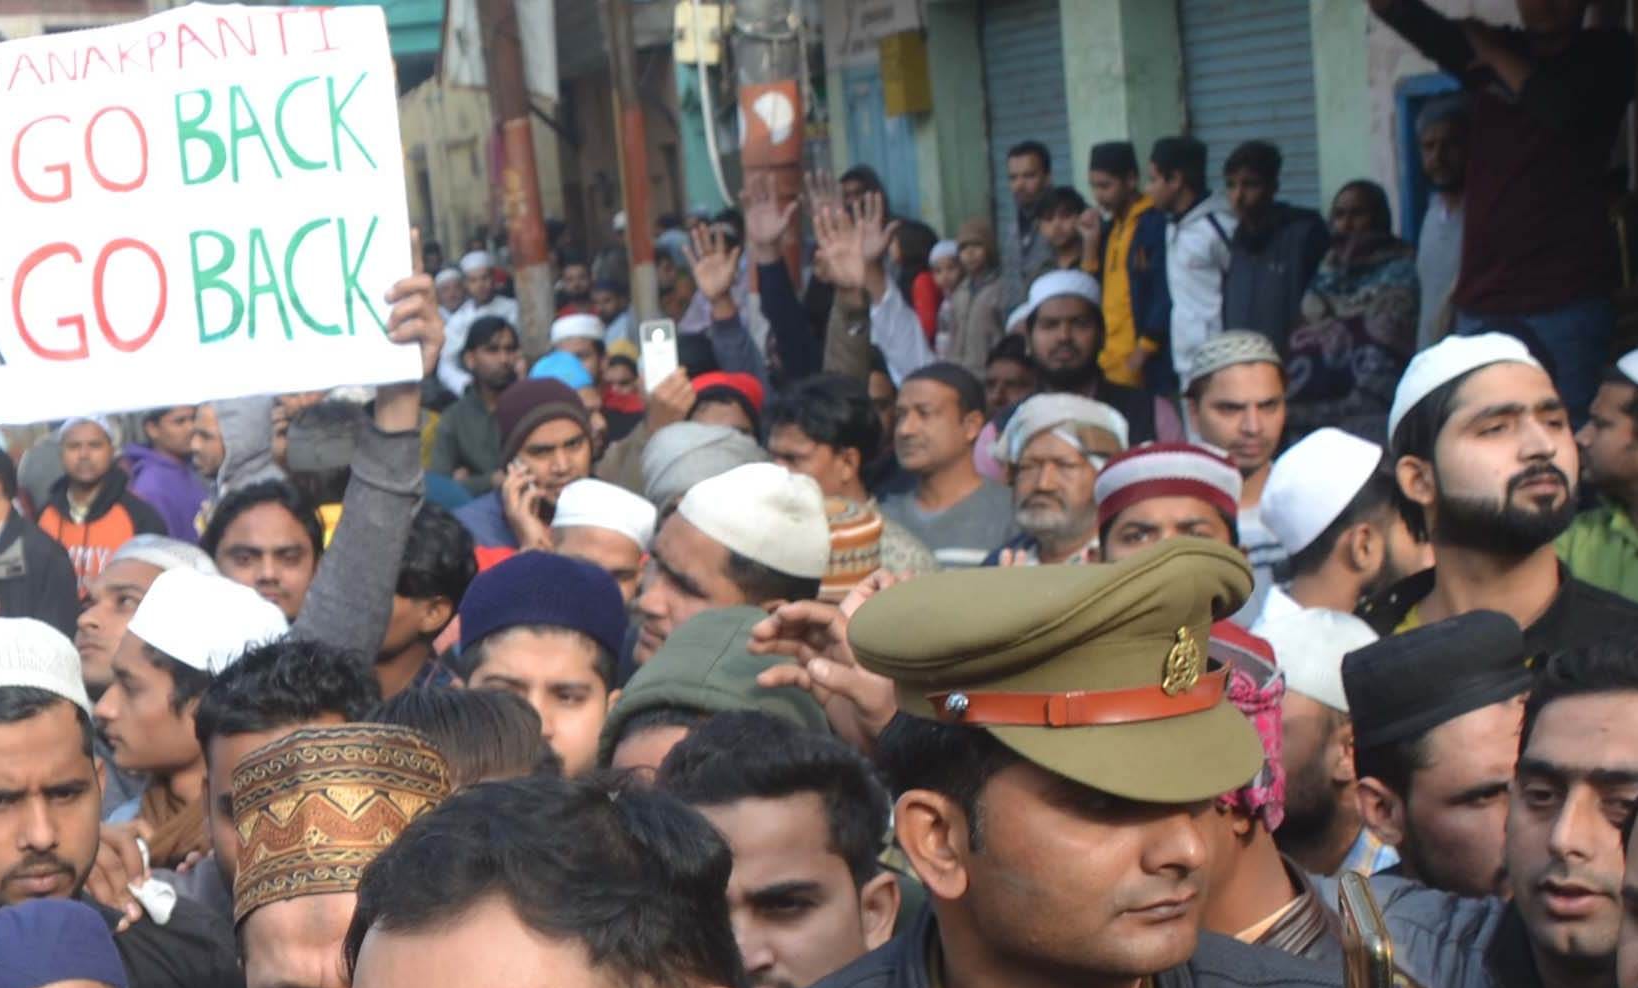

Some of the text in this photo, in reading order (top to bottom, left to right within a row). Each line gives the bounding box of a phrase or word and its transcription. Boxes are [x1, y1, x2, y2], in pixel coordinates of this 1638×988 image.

[11, 106, 149, 204] GO
[174, 71, 378, 185] BACK
[11, 238, 168, 361] GO
[189, 216, 392, 343] BACK
